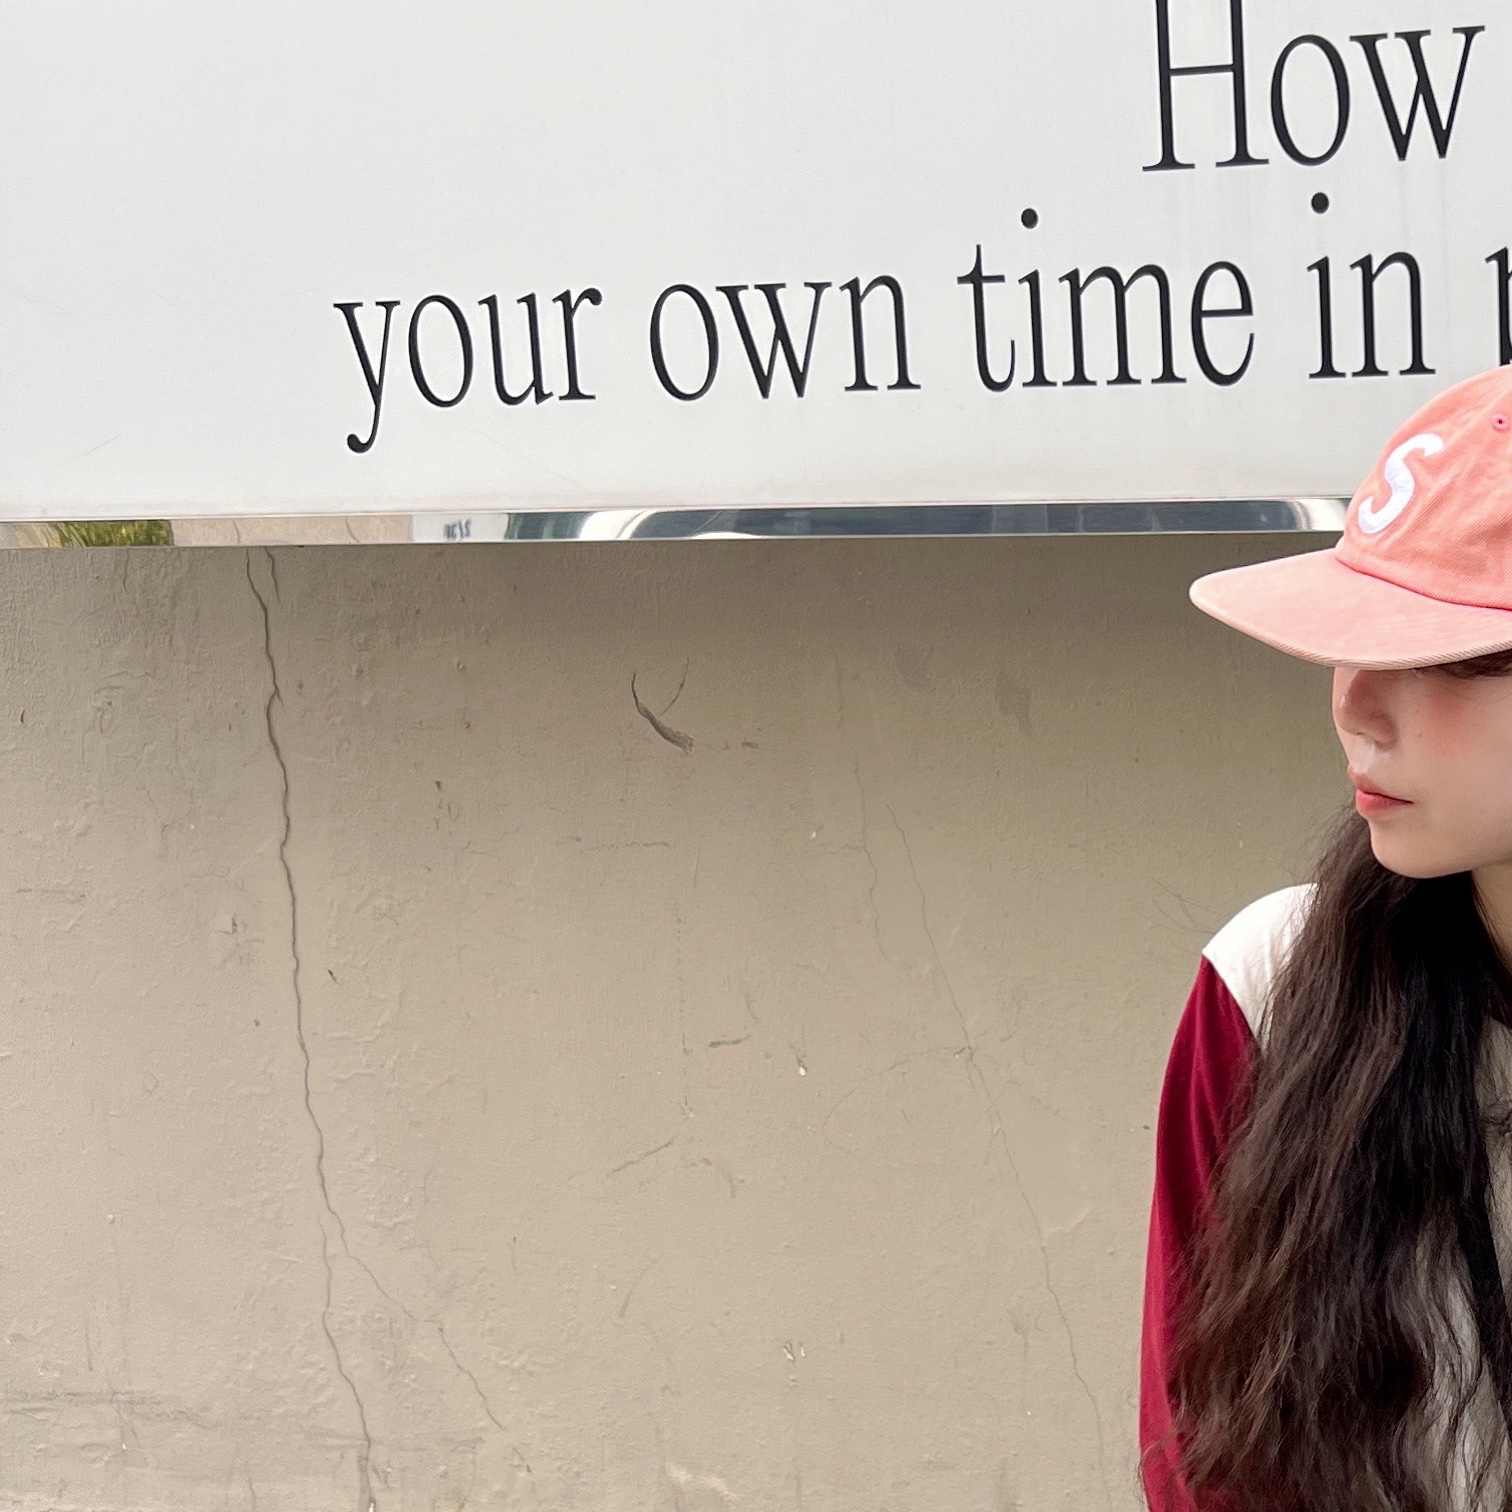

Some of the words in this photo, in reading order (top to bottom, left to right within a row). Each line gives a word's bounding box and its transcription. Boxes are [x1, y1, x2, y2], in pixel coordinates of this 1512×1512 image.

[1143, 0, 1485, 172] How
[333, 287, 603, 454] your
[649, 275, 921, 401] own
[956, 208, 1254, 393] time
[1306, 192, 1436, 379] in
[1357, 432, 1444, 535] S
